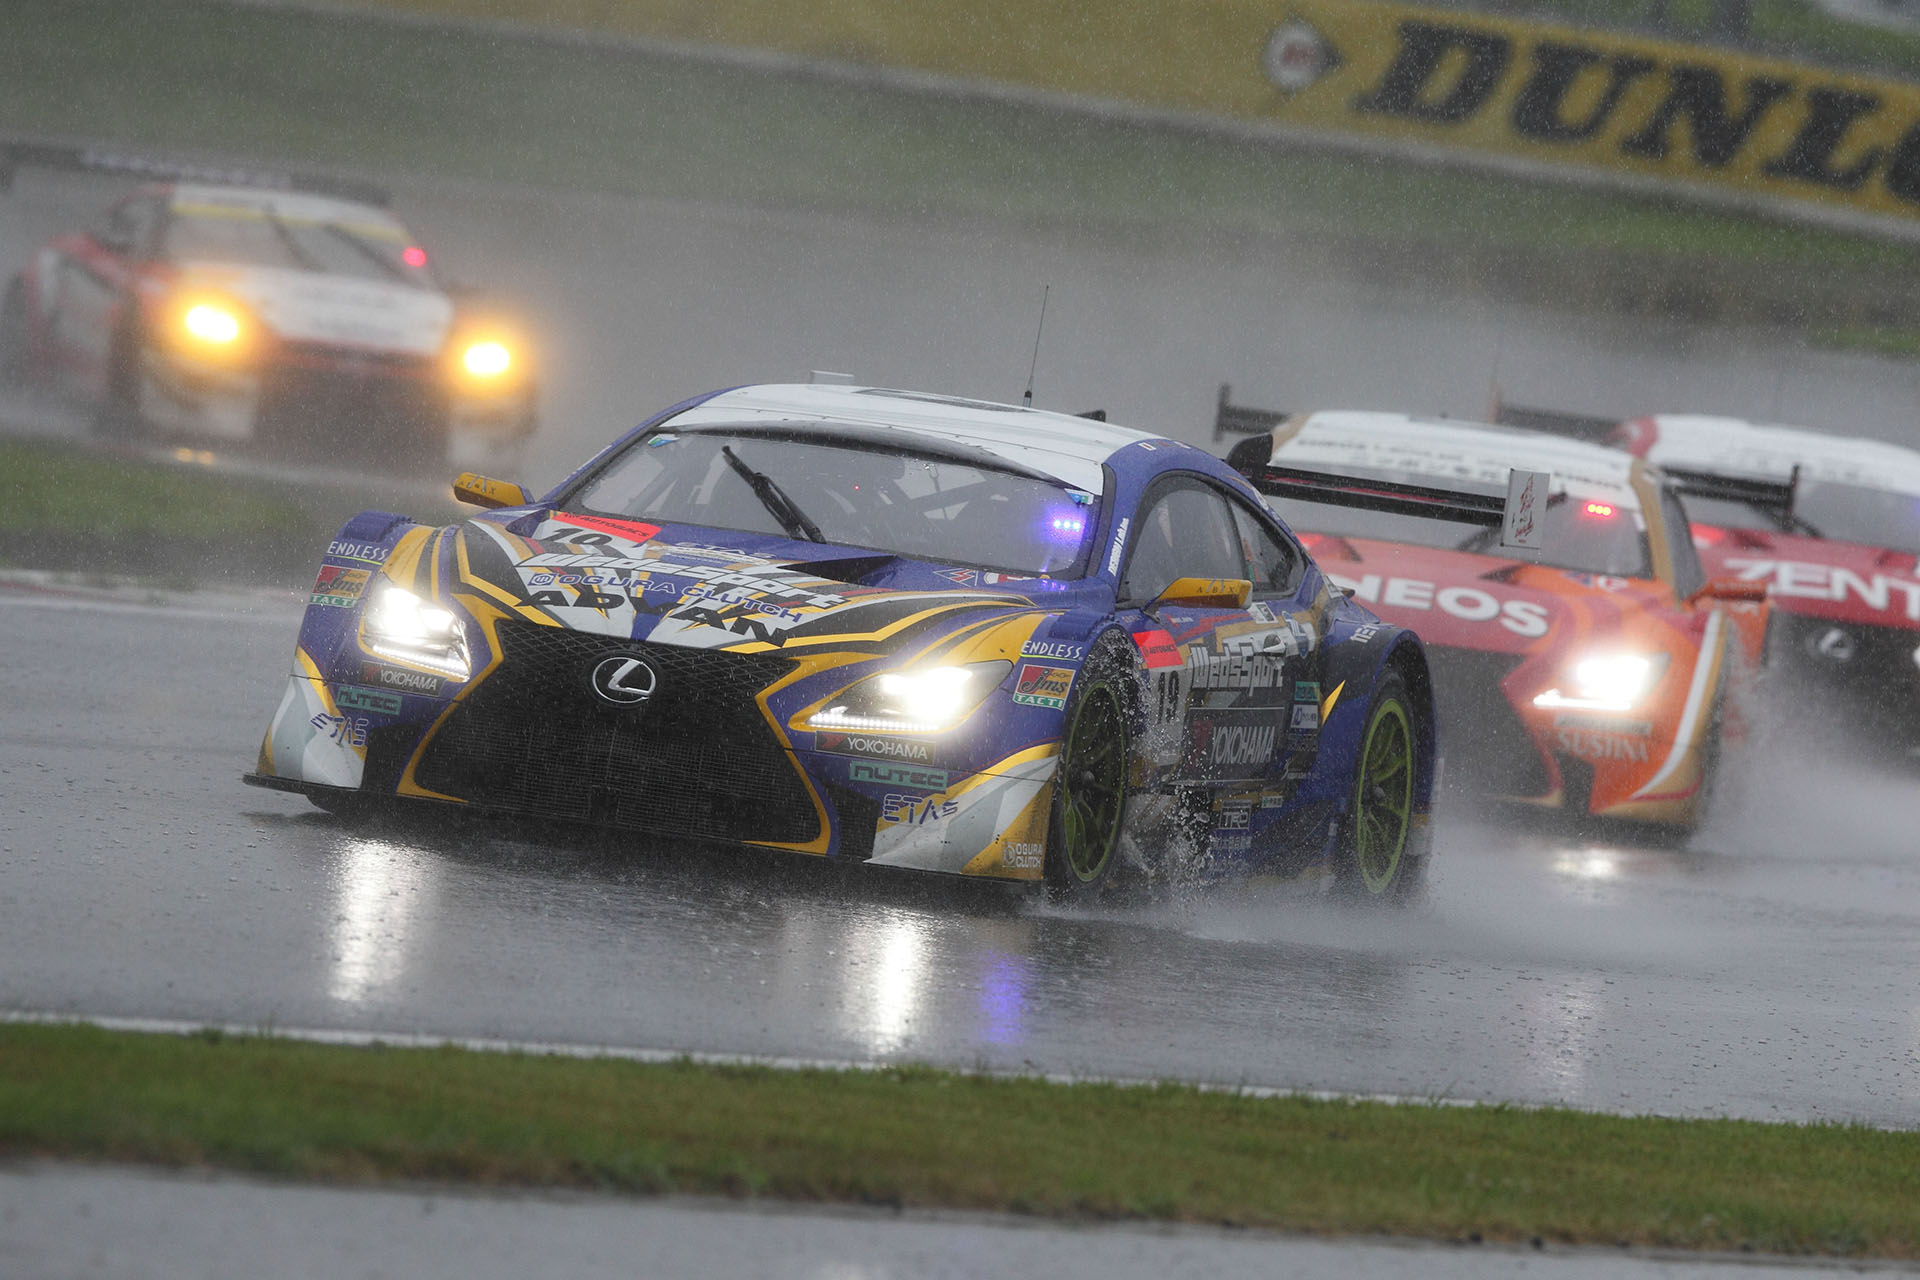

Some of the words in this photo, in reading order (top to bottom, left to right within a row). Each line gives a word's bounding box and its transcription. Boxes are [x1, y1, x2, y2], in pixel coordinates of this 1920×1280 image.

[326, 540, 390, 561] ENDLESS
[311, 594, 358, 607] TACTI
[558, 574, 677, 595] OGURA
[681, 585, 804, 624] CLUTCH
[1326, 573, 1549, 638] NEOS
[514, 590, 788, 648] ADVAN
[1020, 640, 1084, 659] ENDLESS
[379, 669, 438, 692] YOKOHAMA
[1016, 693, 1064, 708] TACTI
[1158, 670, 1180, 724] 19
[847, 736, 928, 760] YOKOHAMA
[1210, 726, 1276, 764] YOKOHAMA
[883, 793, 959, 825] ETAS
[1015, 843, 1043, 856] OGURA
